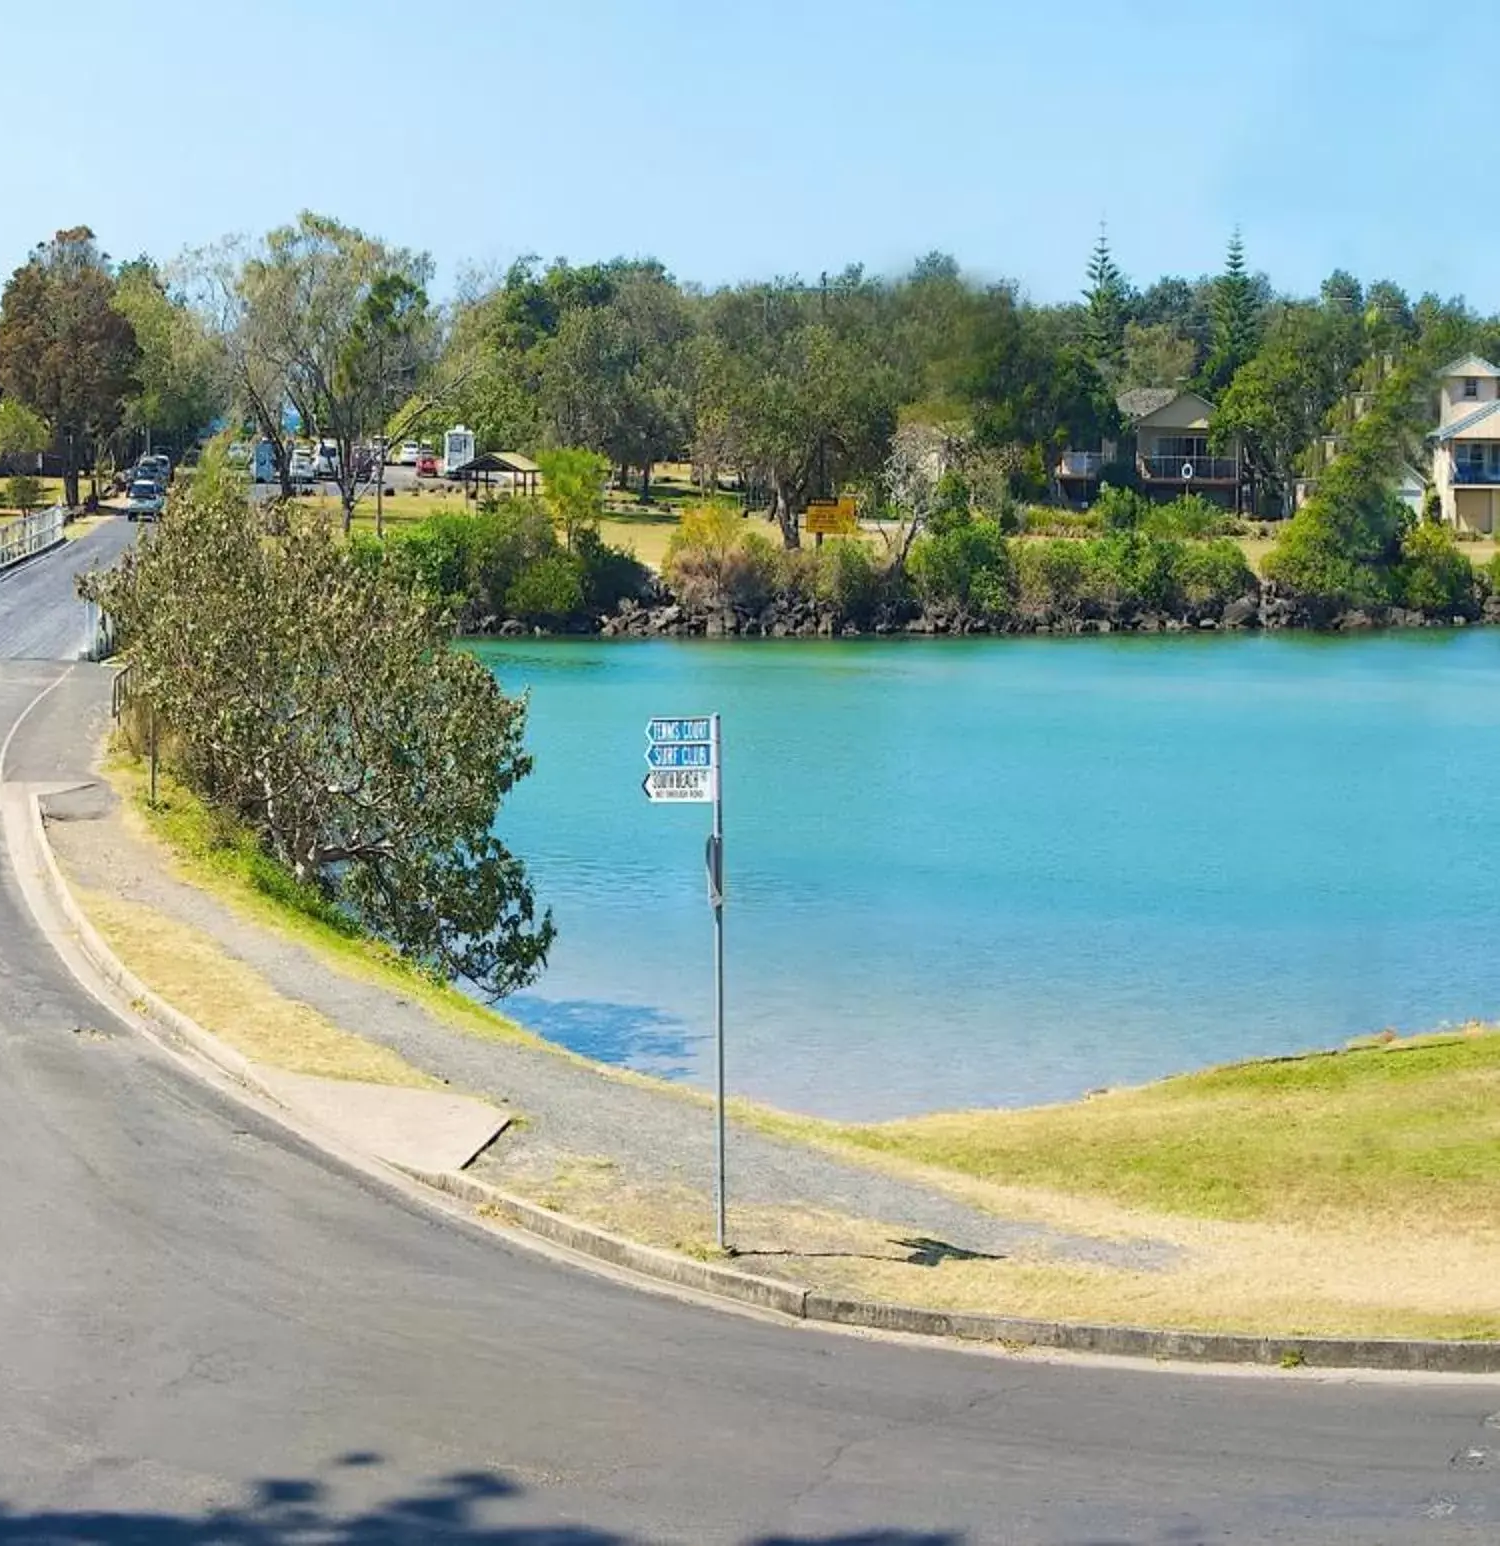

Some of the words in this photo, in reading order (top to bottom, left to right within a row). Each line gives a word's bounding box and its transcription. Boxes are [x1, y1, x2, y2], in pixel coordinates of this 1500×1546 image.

[653, 721, 680, 740] TENNIS
[683, 721, 707, 739] COURT
[654, 747, 679, 765] SURF
[682, 747, 706, 765] CLUB
[653, 771, 674, 788] SOUTH
[676, 770, 698, 788] BEACH
